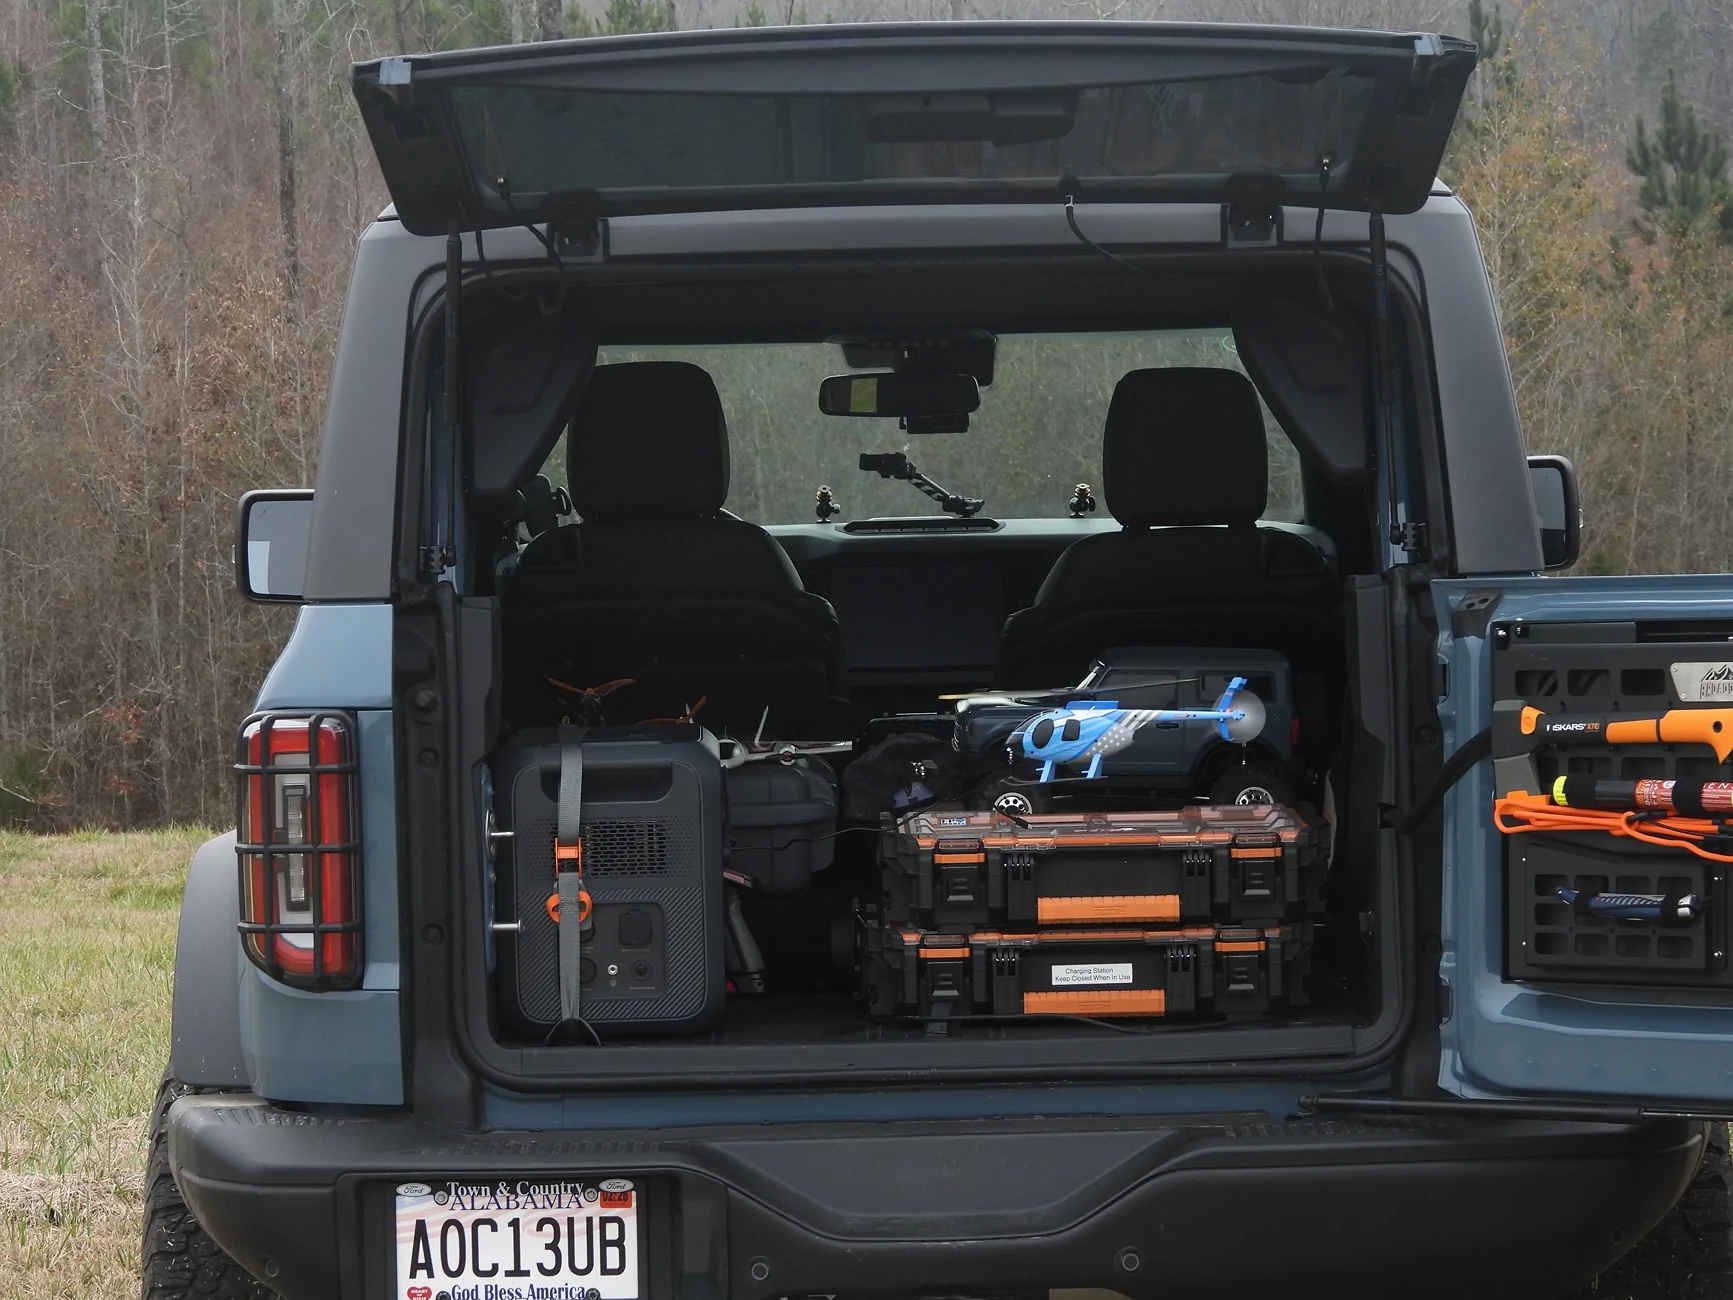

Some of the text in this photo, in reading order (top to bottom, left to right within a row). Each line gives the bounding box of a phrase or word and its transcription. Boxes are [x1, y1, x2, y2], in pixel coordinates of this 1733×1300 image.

[1065, 967, 1092, 975] Charging
[404, 1185, 424, 1194] Ford
[446, 1181, 585, 1198] Town & Country
[606, 1181, 627, 1190] Ford
[449, 1193, 585, 1210] ALABAMA
[451, 1283, 586, 1300] God Bless America
